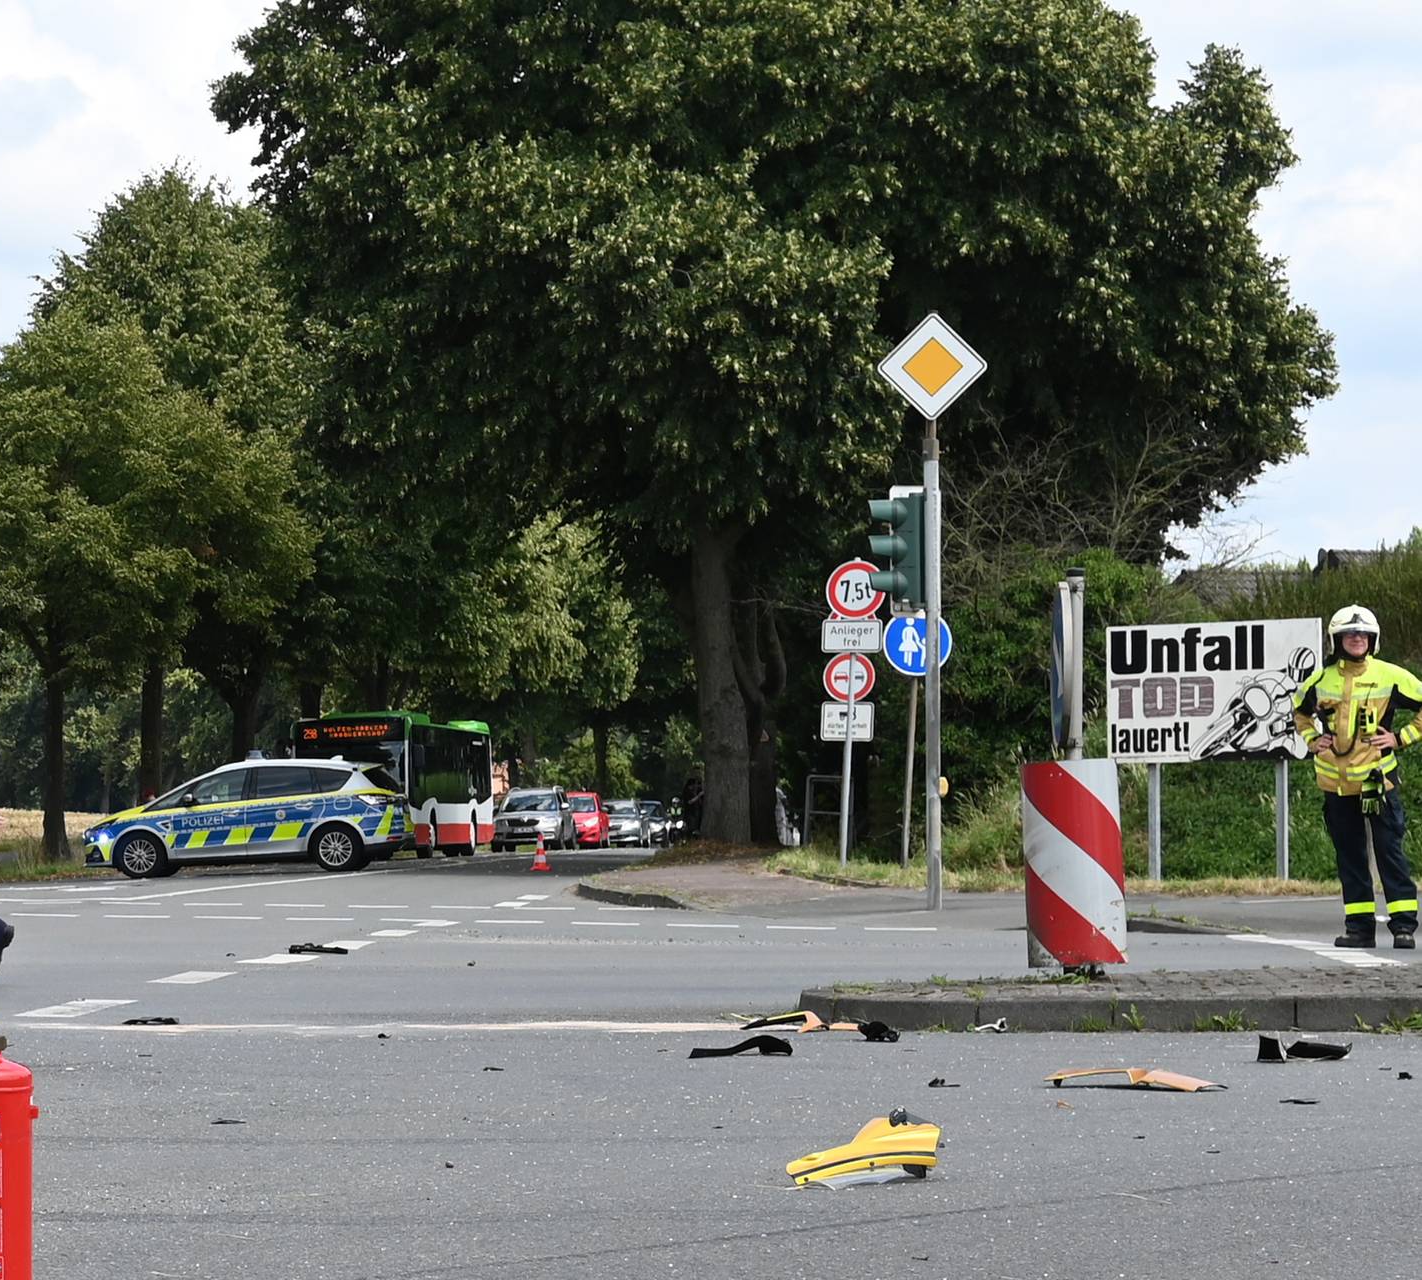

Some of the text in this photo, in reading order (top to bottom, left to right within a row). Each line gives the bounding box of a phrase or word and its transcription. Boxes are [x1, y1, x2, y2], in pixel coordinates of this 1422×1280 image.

[840, 580, 872, 603] 7,5t
[830, 625, 874, 637] Anlieger
[843, 637, 861, 647] frei
[1110, 624, 1265, 675] Unfall
[1110, 676, 1215, 719] TOD
[1111, 722, 1190, 754] lauert!
[181, 815, 224, 828] POLIZEI
